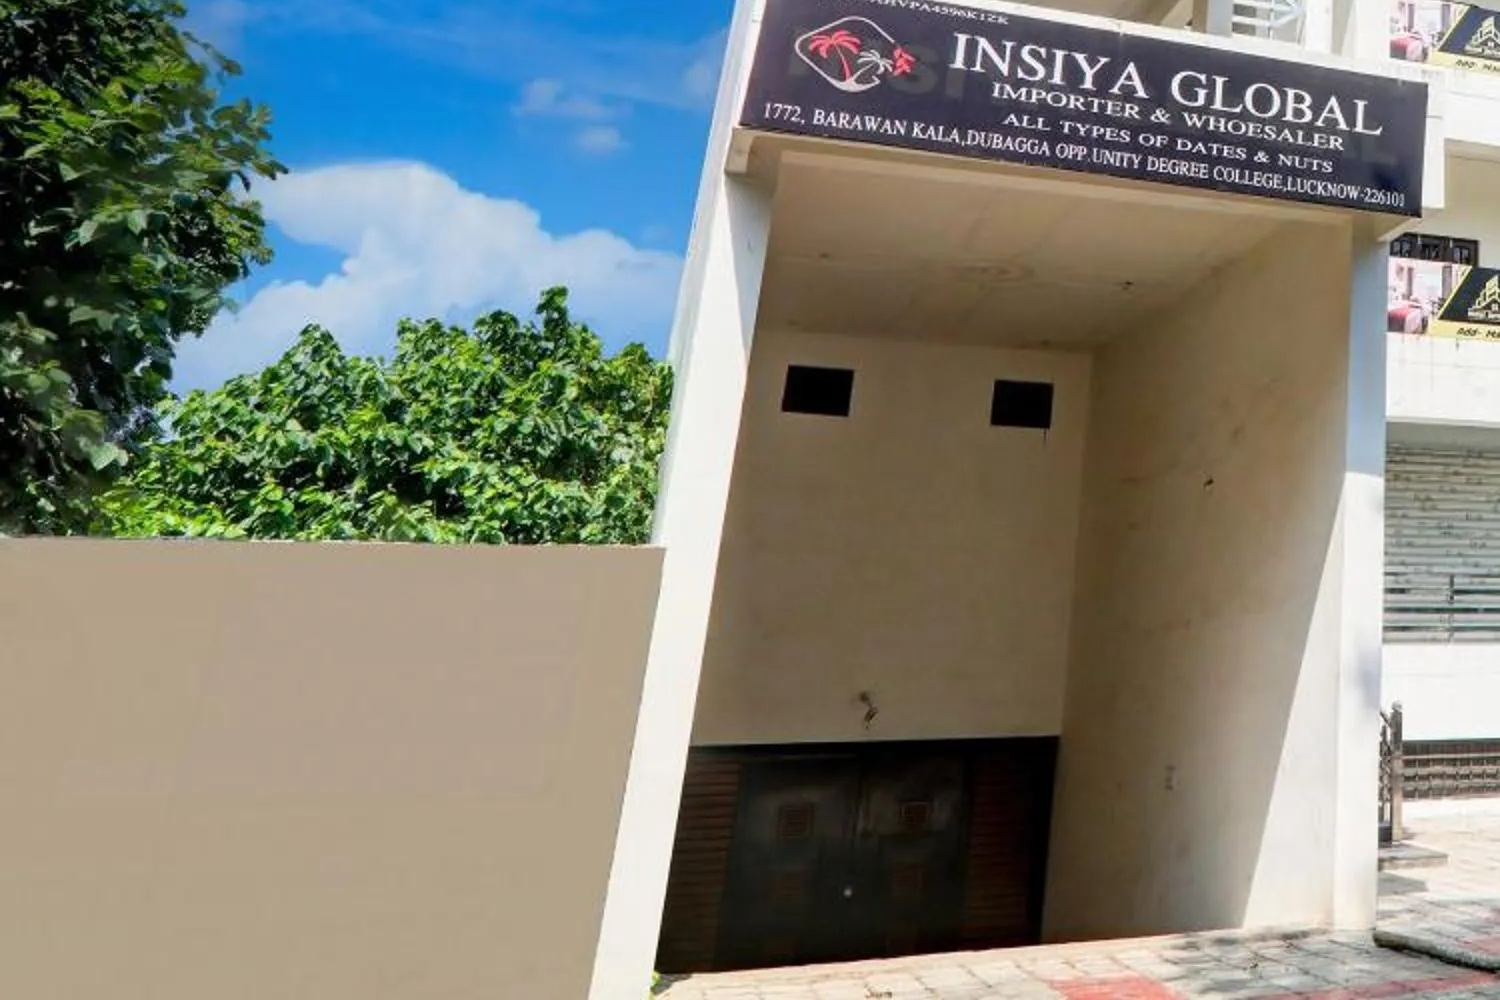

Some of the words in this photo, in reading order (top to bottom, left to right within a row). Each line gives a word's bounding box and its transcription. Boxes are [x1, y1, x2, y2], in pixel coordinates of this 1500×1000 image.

[950, 31, 1149, 99] INSIYA
[1171, 70, 1383, 136] GLOBAL
[992, 81, 1140, 119] IMPORTER
[1150, 107, 1171, 124] &
[1182, 111, 1345, 151] WHOESALER
[812, 107, 907, 137] BARAWAN
[1146, 155, 1209, 179] DEGREE
[1001, 113, 1051, 131] ALL
[1059, 120, 1131, 143] TYPES
[1138, 133, 1169, 148] OF
[1175, 138, 1247, 160] DATES
[1253, 150, 1270, 164] &
[1278, 153, 1334, 173] NUTS
